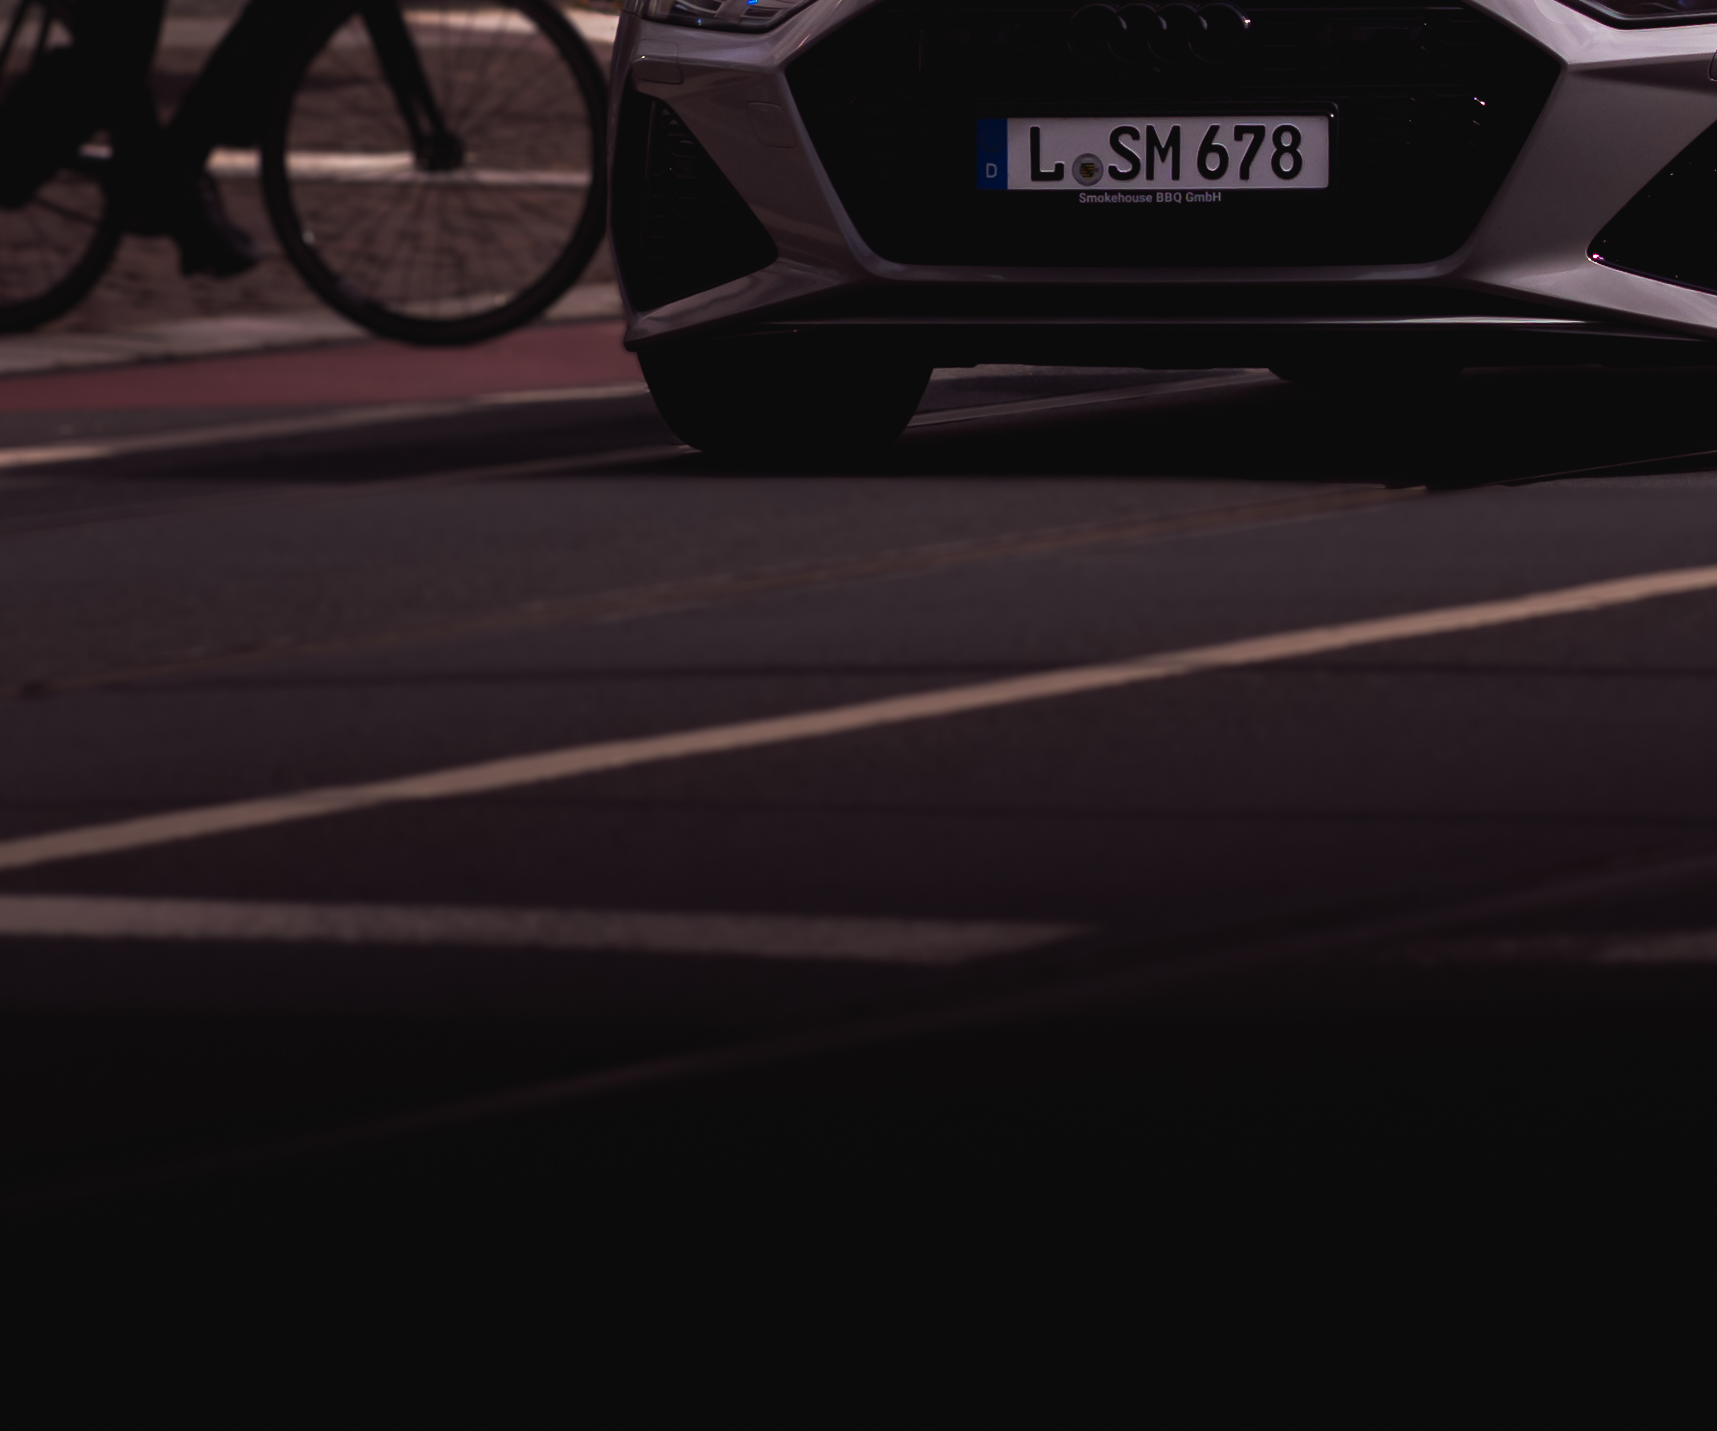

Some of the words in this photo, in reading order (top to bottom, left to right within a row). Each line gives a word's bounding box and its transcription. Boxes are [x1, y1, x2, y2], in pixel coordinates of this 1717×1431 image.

[1029, 125, 1065, 182] L
[1108, 124, 1182, 181] SM
[1196, 124, 1304, 181] 678
[985, 163, 998, 179] D
[1079, 192, 1153, 204] Smokehouse
[1156, 192, 1182, 204] BBQ
[1185, 191, 1222, 203] GmbH
